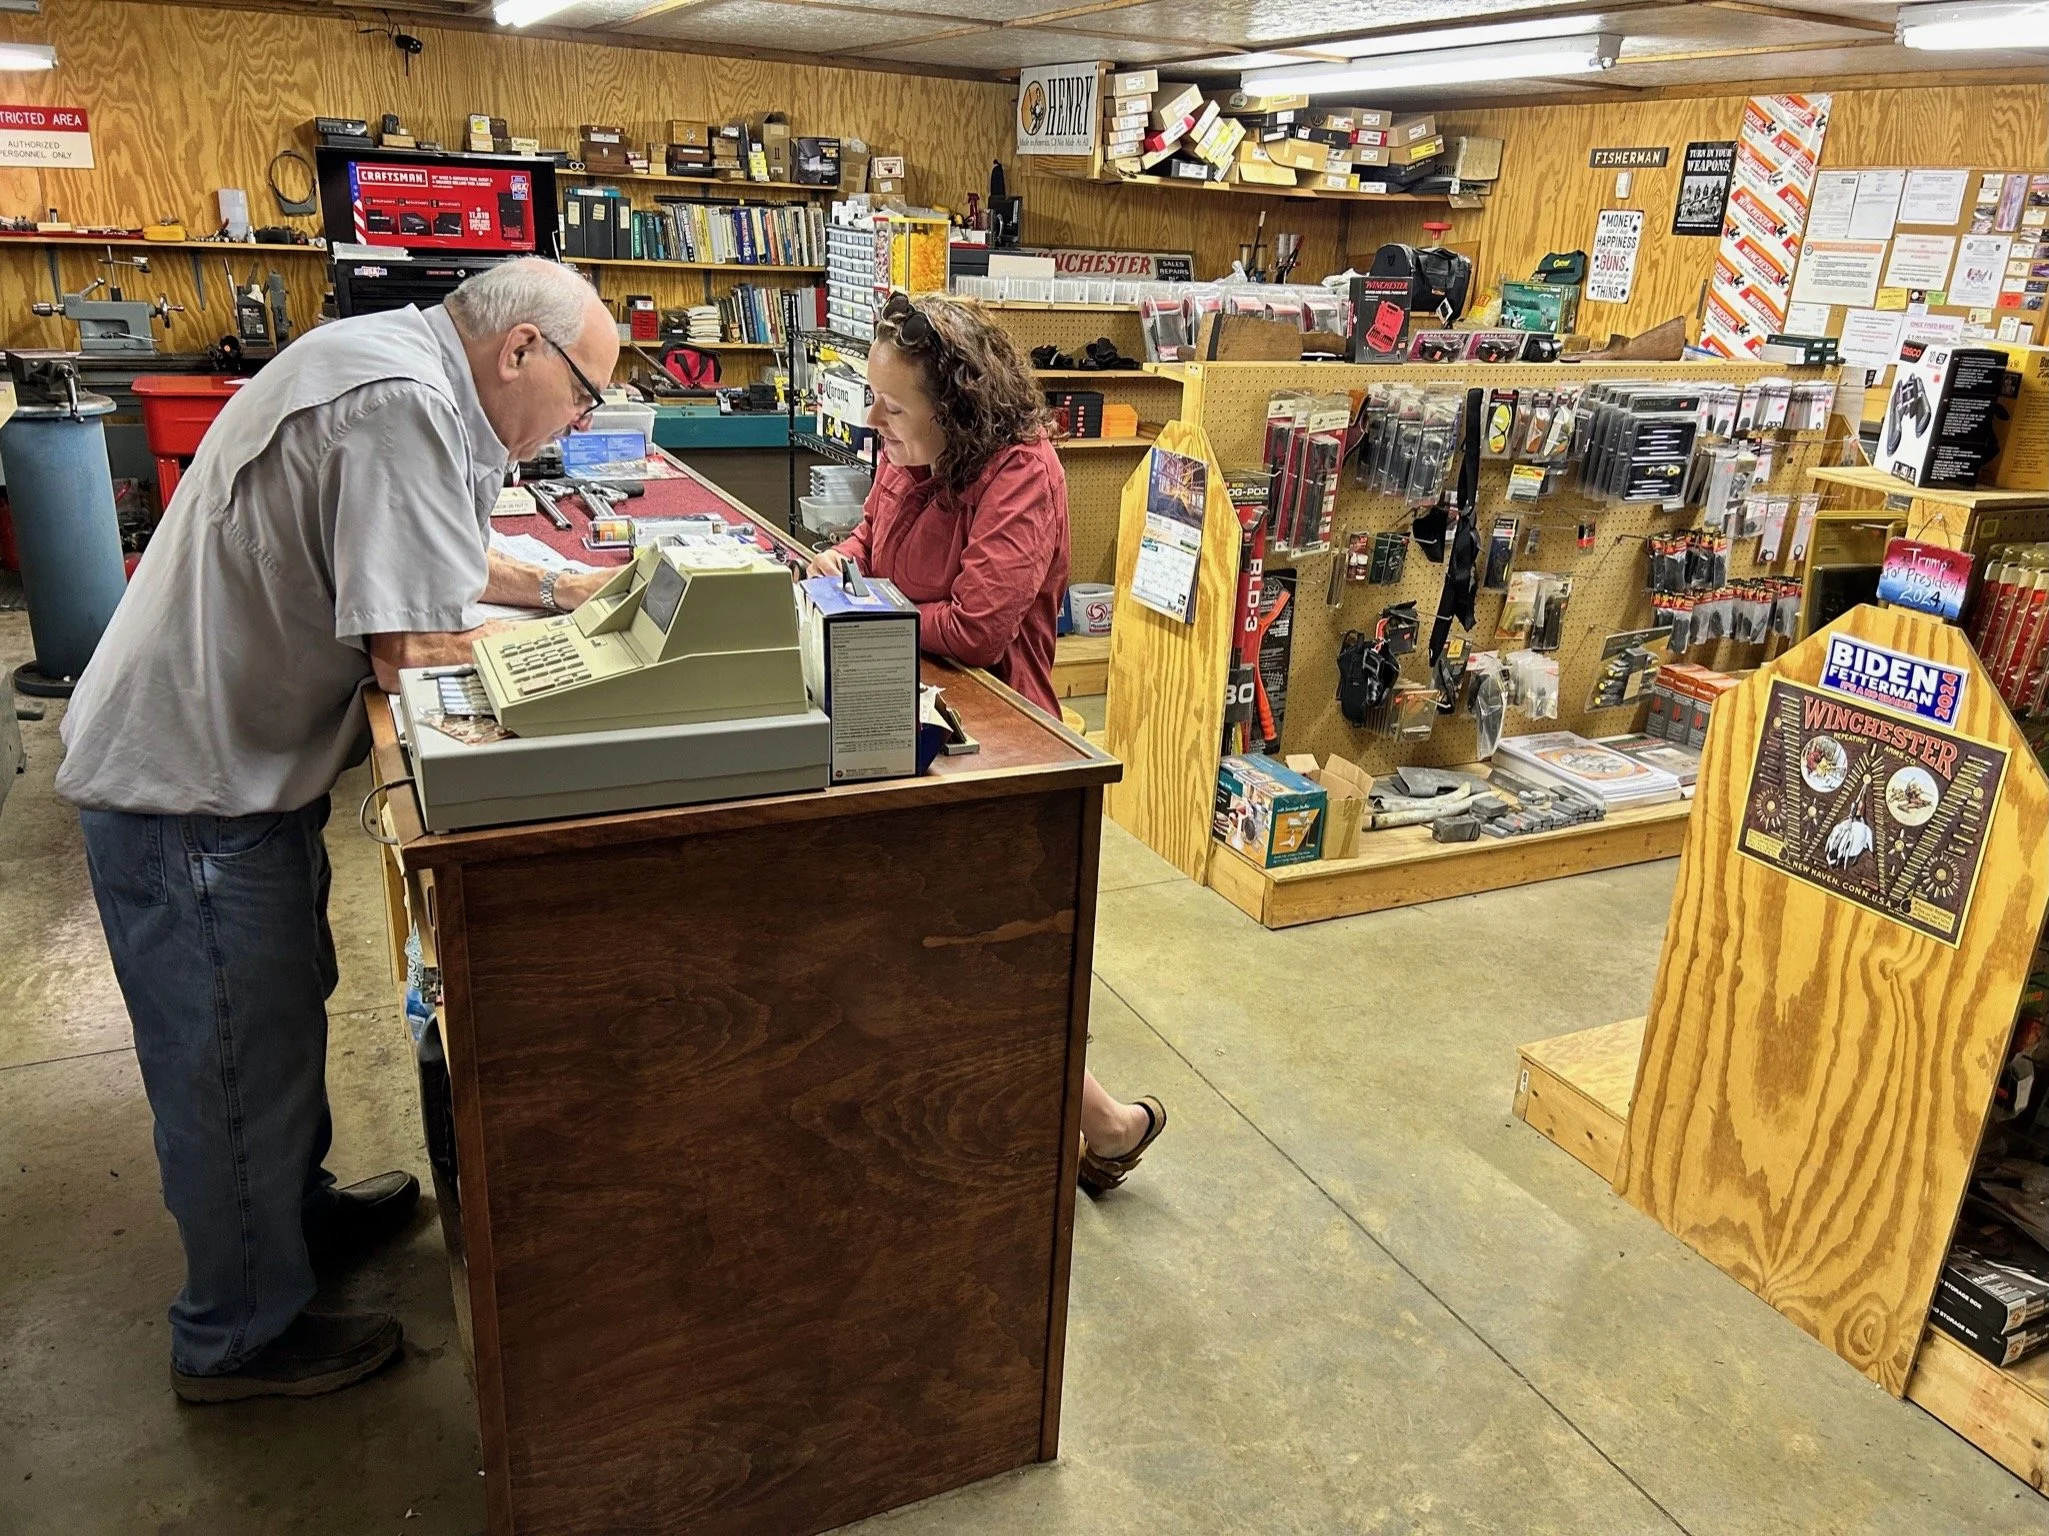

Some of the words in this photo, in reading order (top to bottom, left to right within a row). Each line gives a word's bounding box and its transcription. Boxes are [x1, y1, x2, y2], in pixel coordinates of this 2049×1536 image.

[1045, 75, 1094, 136] HENRY
[53, 113, 82, 127] AREA
[8, 140, 60, 149] AUTHORIZED
[52, 151, 72, 159] ONLY
[1594, 152, 1661, 164] FISHERMAN
[1689, 149, 1706, 158] TURN
[1706, 149, 1715, 158] IN
[1715, 148, 1732, 158] YOUR
[1686, 159, 1731, 173] WEAPONS.
[361, 171, 425, 183] CRAFTSMAN
[1606, 214, 1635, 228] MONEY
[1597, 235, 1637, 249] HAPPINESS
[1036, 252, 1151, 276] NCHESTER
[1600, 254, 1627, 272] GUNS
[1742, 243, 1780, 284] WINCHESTER
[1364, 281, 1408, 289] WINCHESTER
[1902, 345, 1921, 358] tasco
[826, 380, 849, 402] Corona
[1883, 562, 1903, 580] for
[1905, 567, 1962, 596] President
[1831, 640, 1939, 694] BIDEN
[1829, 665, 1934, 707] FETTERMAN
[1934, 672, 1958, 720] 2024
[1804, 695, 1958, 780] WINCHESTER
[1833, 732, 1868, 745] REPEATING
[1883, 745, 1904, 760] ARMS
[1792, 861, 1810, 873] NEW
[1944, 1281, 1969, 1302] STORAGE
[1969, 1297, 1982, 1310] BOX
[1940, 1310, 1965, 1331] STORAGE
[1965, 1327, 1978, 1340] BOX
